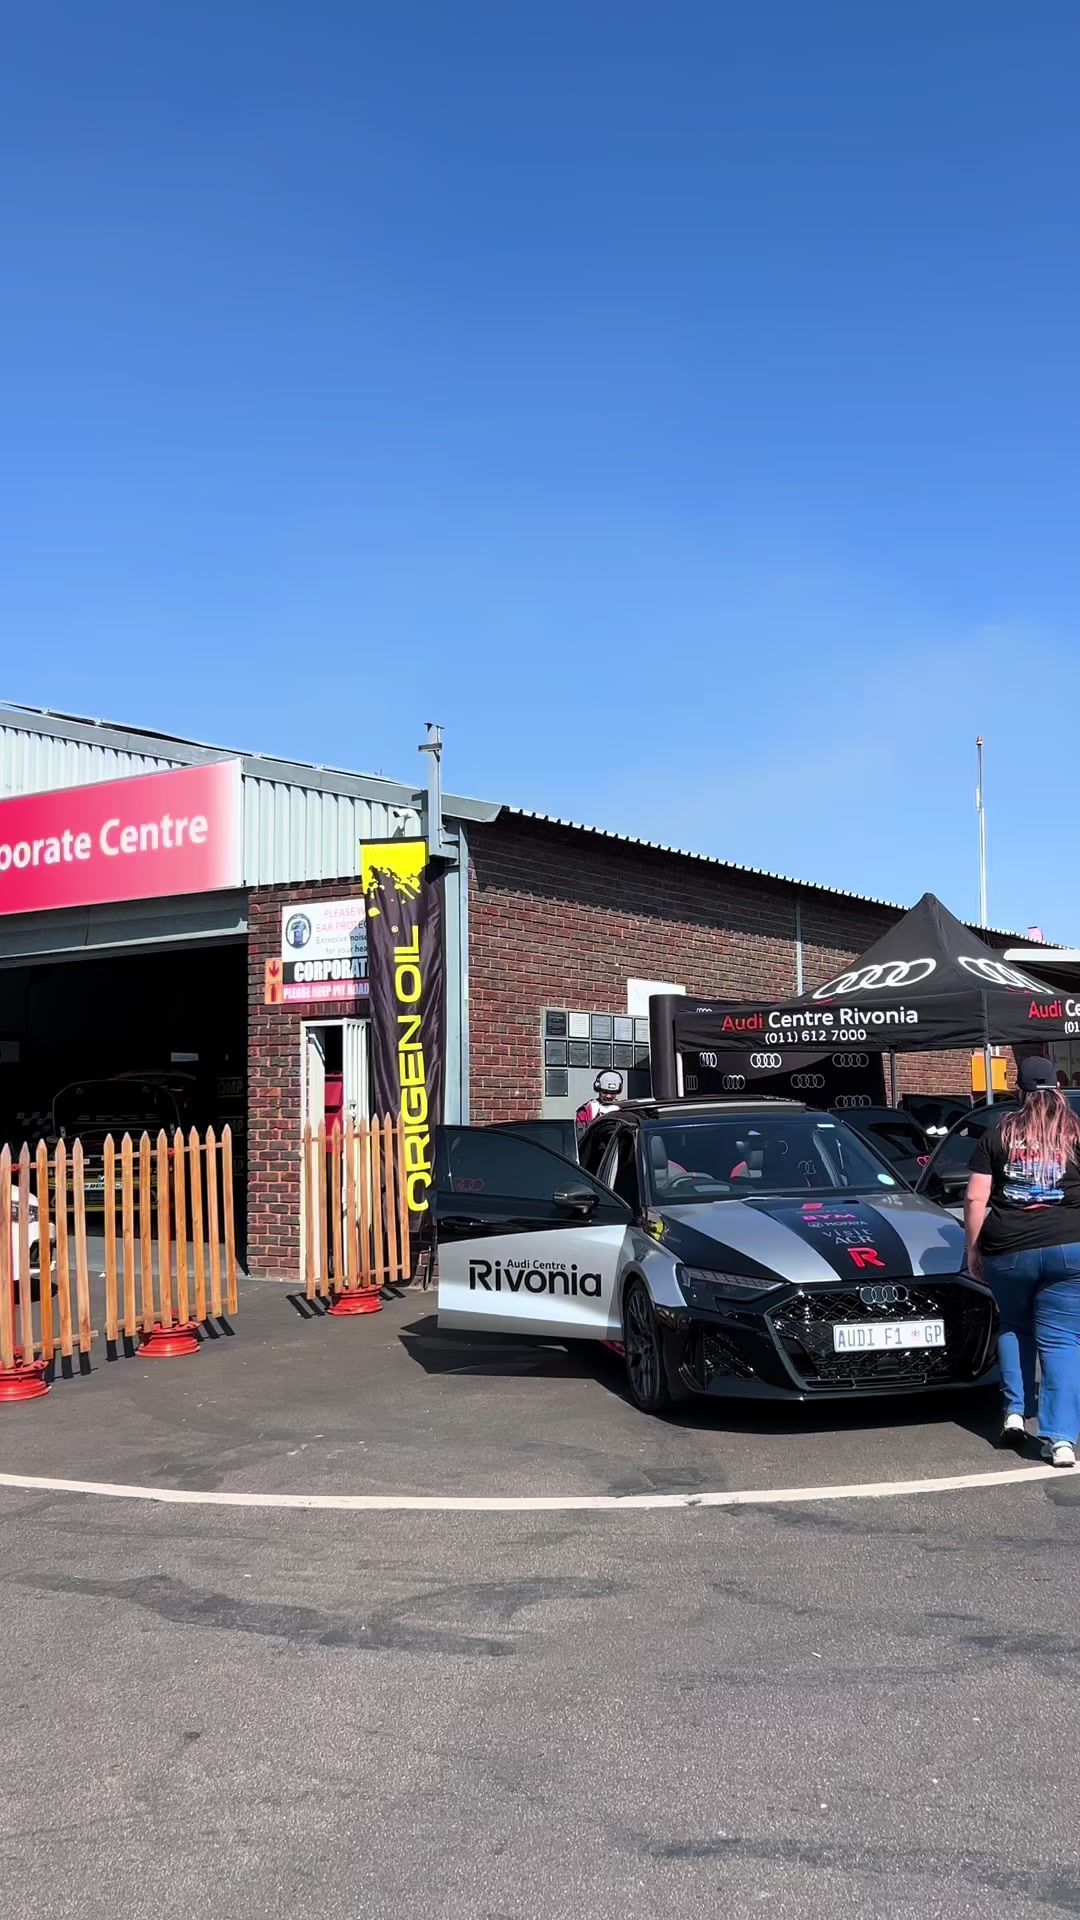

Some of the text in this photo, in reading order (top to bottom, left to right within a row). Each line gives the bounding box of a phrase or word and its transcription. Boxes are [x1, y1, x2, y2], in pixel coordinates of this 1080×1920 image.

[100, 814, 208, 856] Centre
[324, 907, 355, 918] PLEASE
[316, 923, 333, 933] EAR
[316, 935, 348, 945] Excessive
[325, 946, 336, 954] for
[338, 947, 353, 956] your
[283, 986, 310, 999] PLEASE
[1029, 1000, 1062, 1018] Audi
[721, 1006, 918, 1032] Audi Centre Rivonia
[765, 1029, 867, 1045] (011) 612 7000
[394, 925, 432, 1222] ORIGEN OIL
[835, 1235, 875, 1245] ACR
[507, 1259, 566, 1271] Audi Centre
[847, 1247, 886, 1268] R
[469, 1259, 602, 1297] Rivonia
[838, 1325, 942, 1348] AUDI F1 GP
